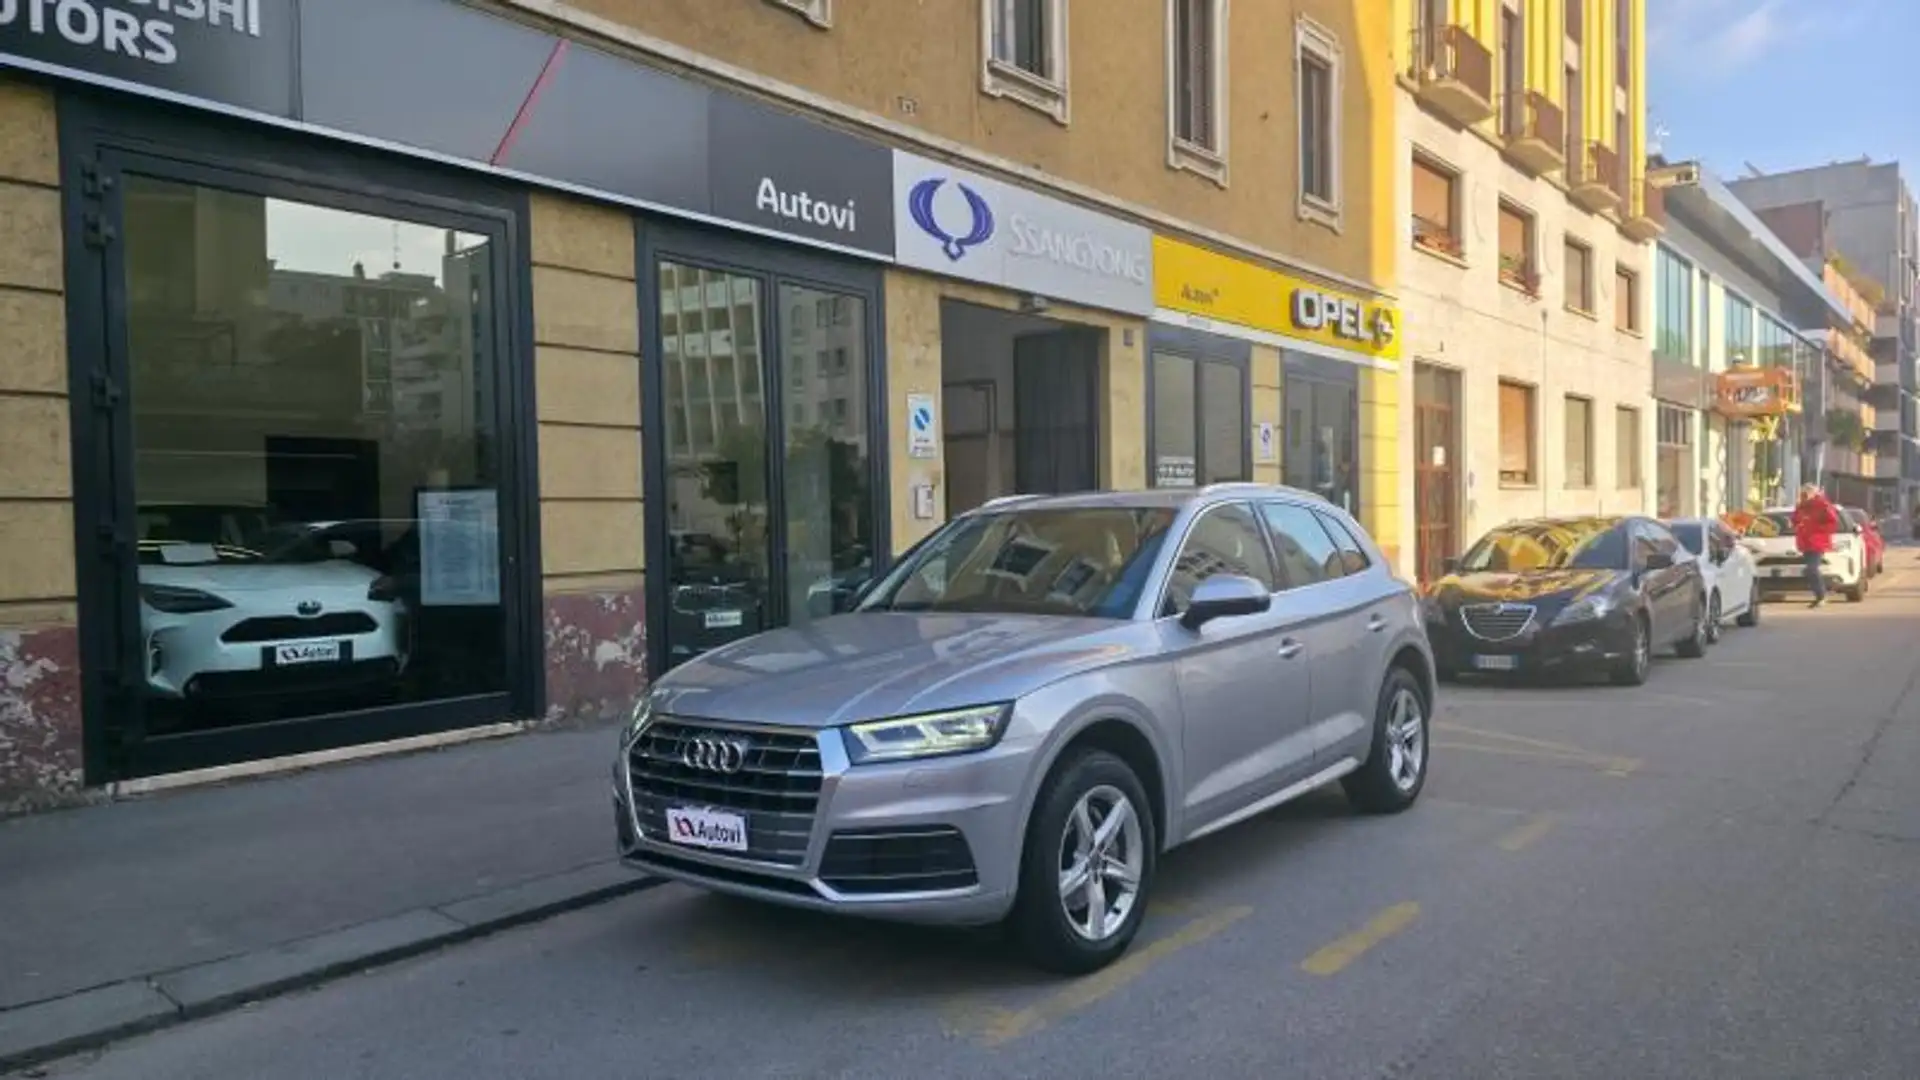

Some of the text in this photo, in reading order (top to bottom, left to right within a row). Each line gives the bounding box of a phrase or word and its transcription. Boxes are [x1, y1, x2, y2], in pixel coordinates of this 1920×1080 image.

[0, 0, 177, 64] TORS
[757, 178, 855, 231] Autovi
[1291, 288, 1374, 341] OPEL
[698, 819, 742, 844] Autovi
